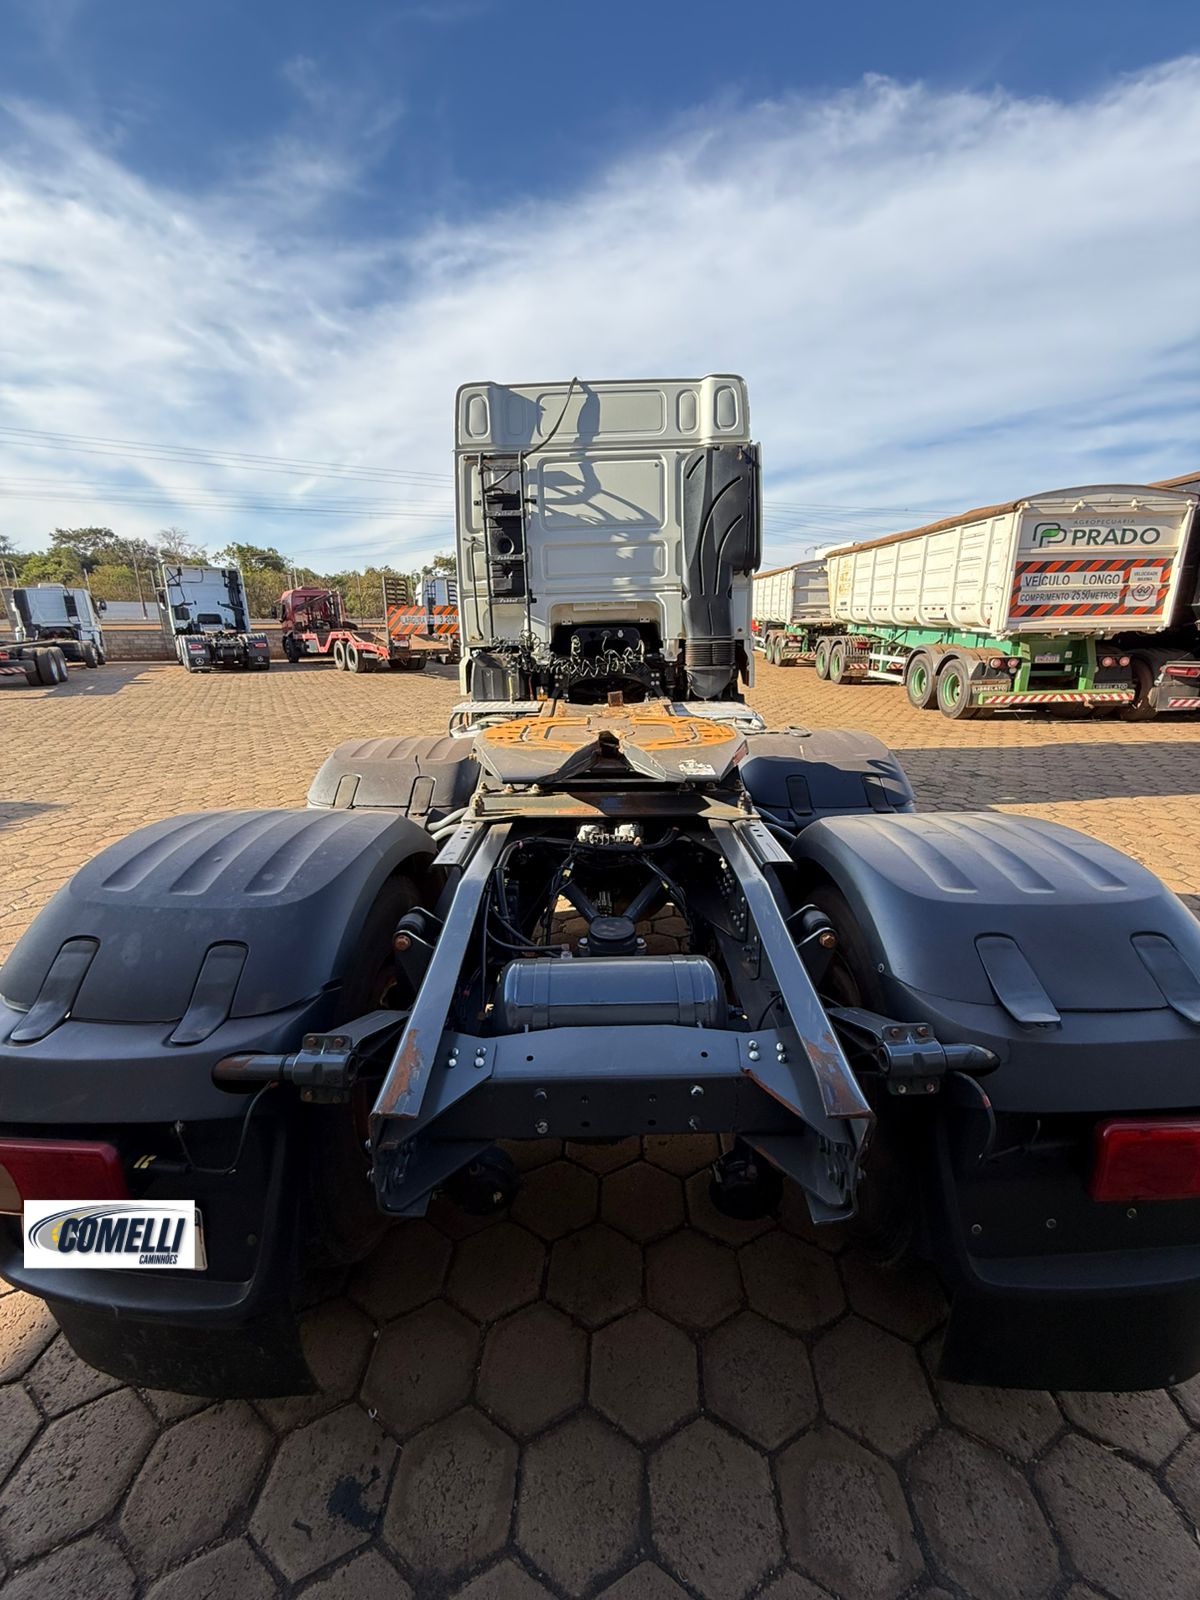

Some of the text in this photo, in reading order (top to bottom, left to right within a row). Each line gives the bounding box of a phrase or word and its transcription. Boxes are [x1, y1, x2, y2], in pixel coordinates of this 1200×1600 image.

[1071, 527, 1161, 546] PRADO
[1025, 573, 1121, 587] VEÍCULO LONGO
[1020, 592, 1070, 602] COMPRIMENTO
[1090, 591, 1118, 600] METROS
